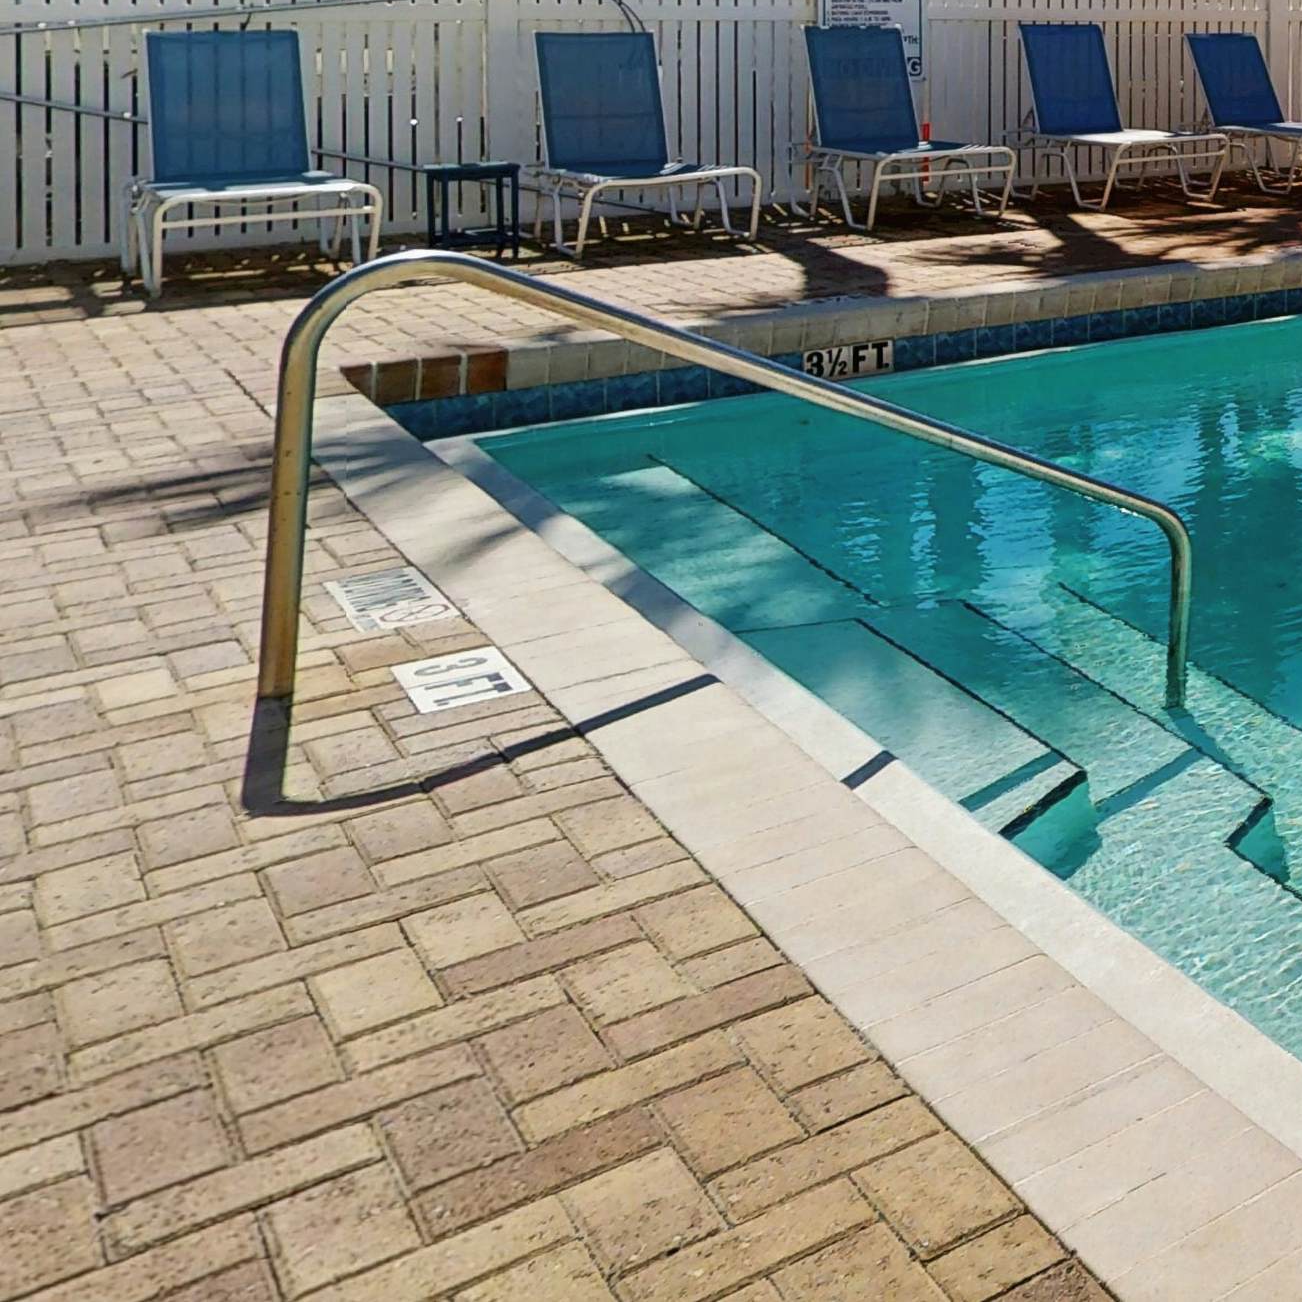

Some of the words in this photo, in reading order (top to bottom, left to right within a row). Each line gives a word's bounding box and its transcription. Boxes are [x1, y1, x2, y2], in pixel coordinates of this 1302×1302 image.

[852, 341, 890, 373] FT.
[413, 656, 488, 677] 3
[424, 671, 514, 707] FT.
